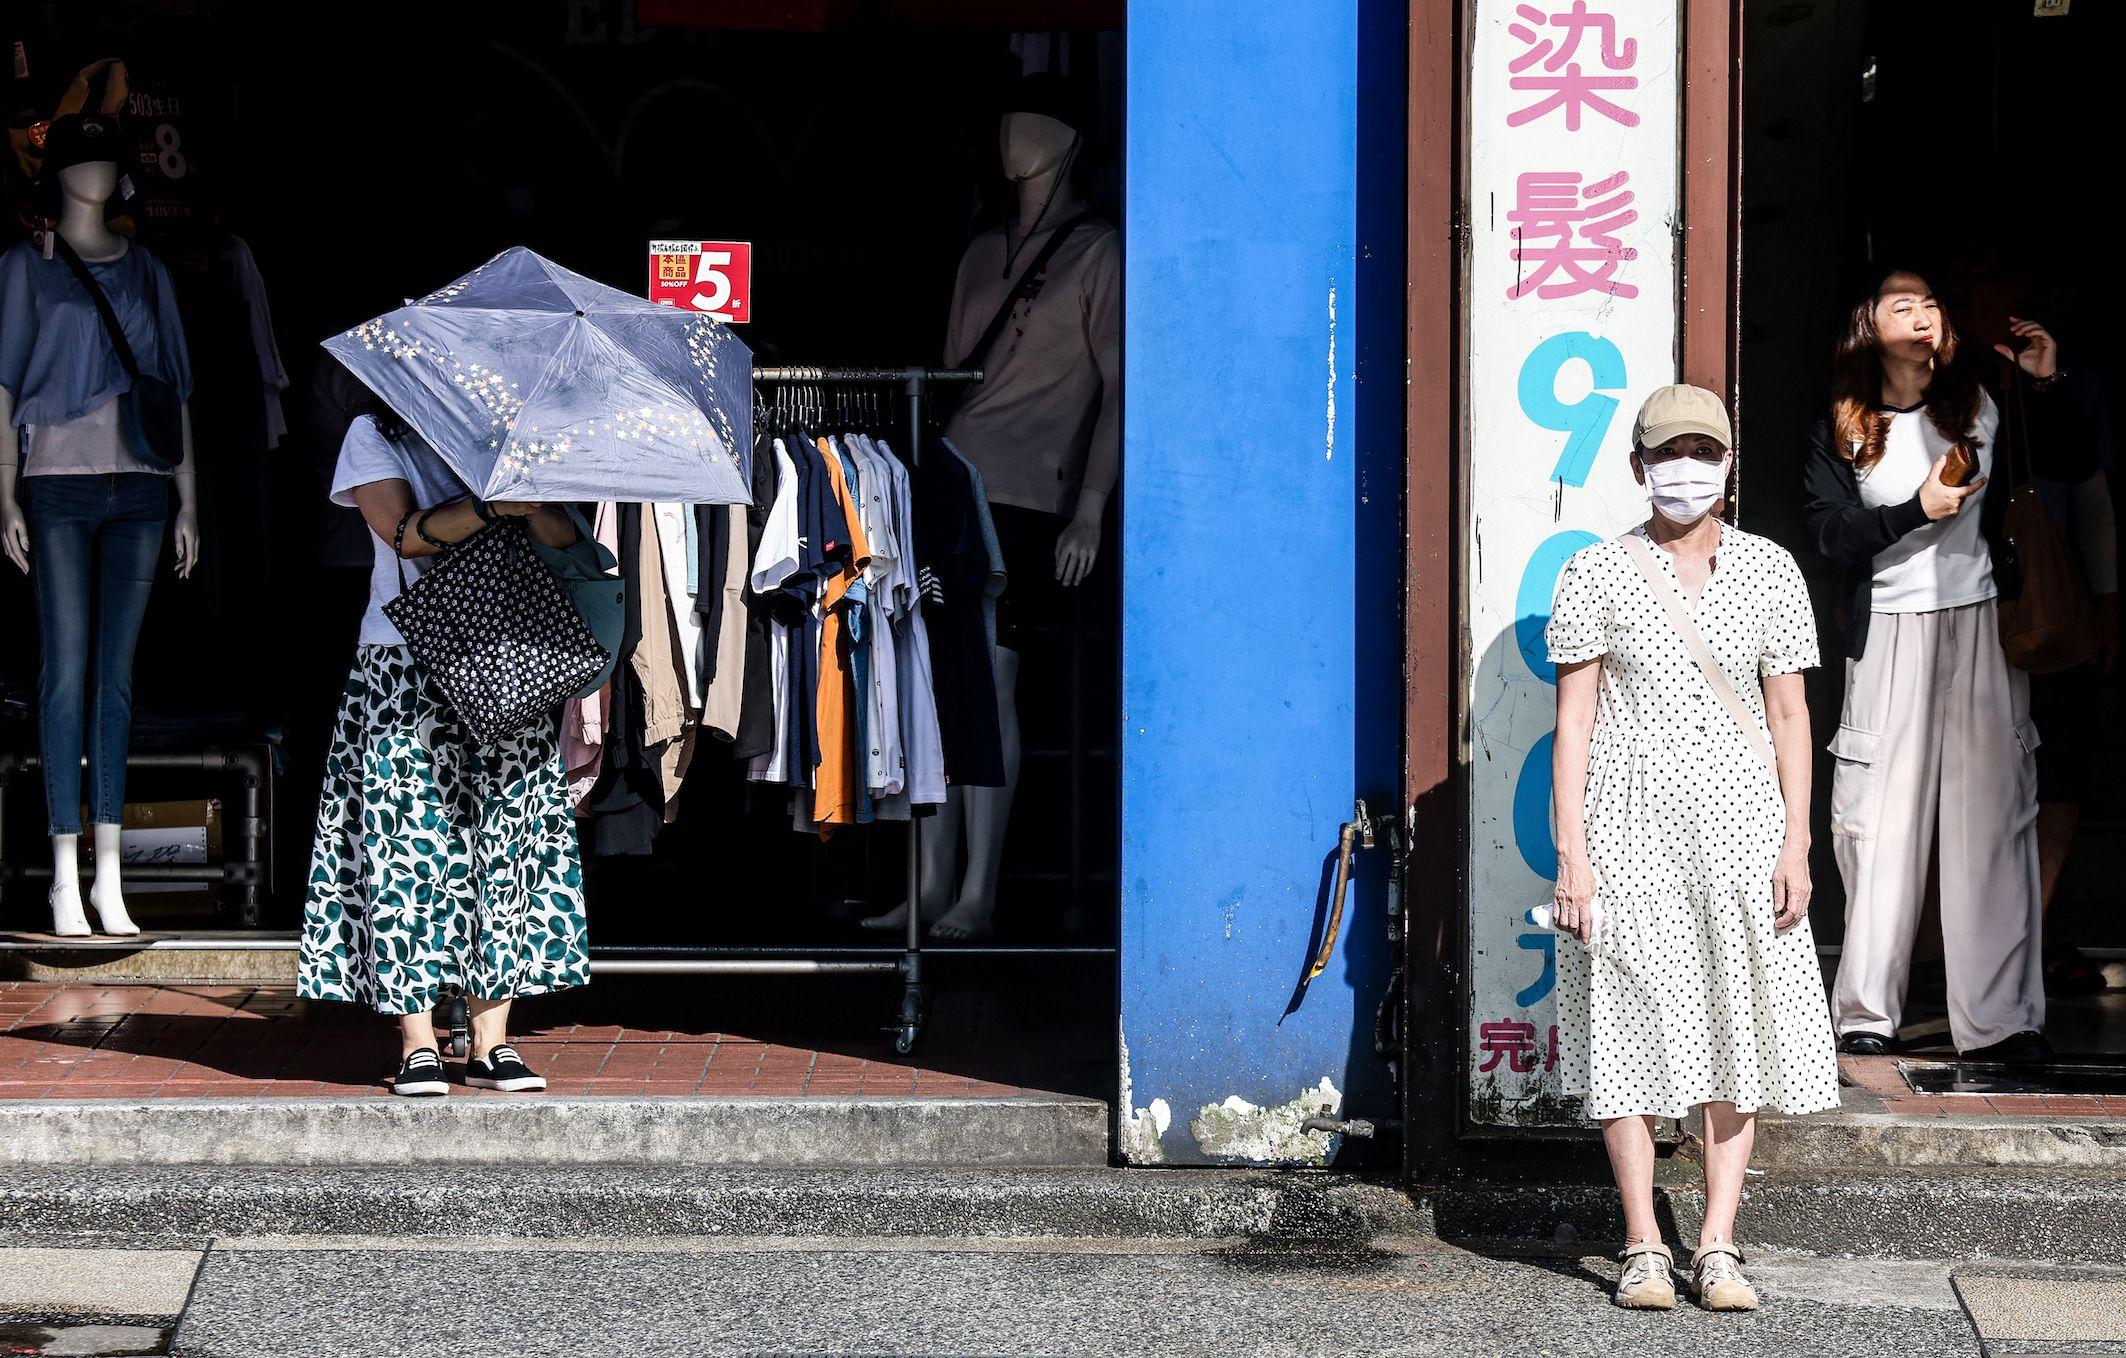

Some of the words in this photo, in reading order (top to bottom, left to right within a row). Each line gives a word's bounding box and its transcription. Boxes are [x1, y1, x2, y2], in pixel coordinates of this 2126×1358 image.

[155, 123, 187, 179] 8
[1506, 0, 1641, 300] 染髮
[662, 266, 687, 278] 商品
[690, 251, 732, 311] 5
